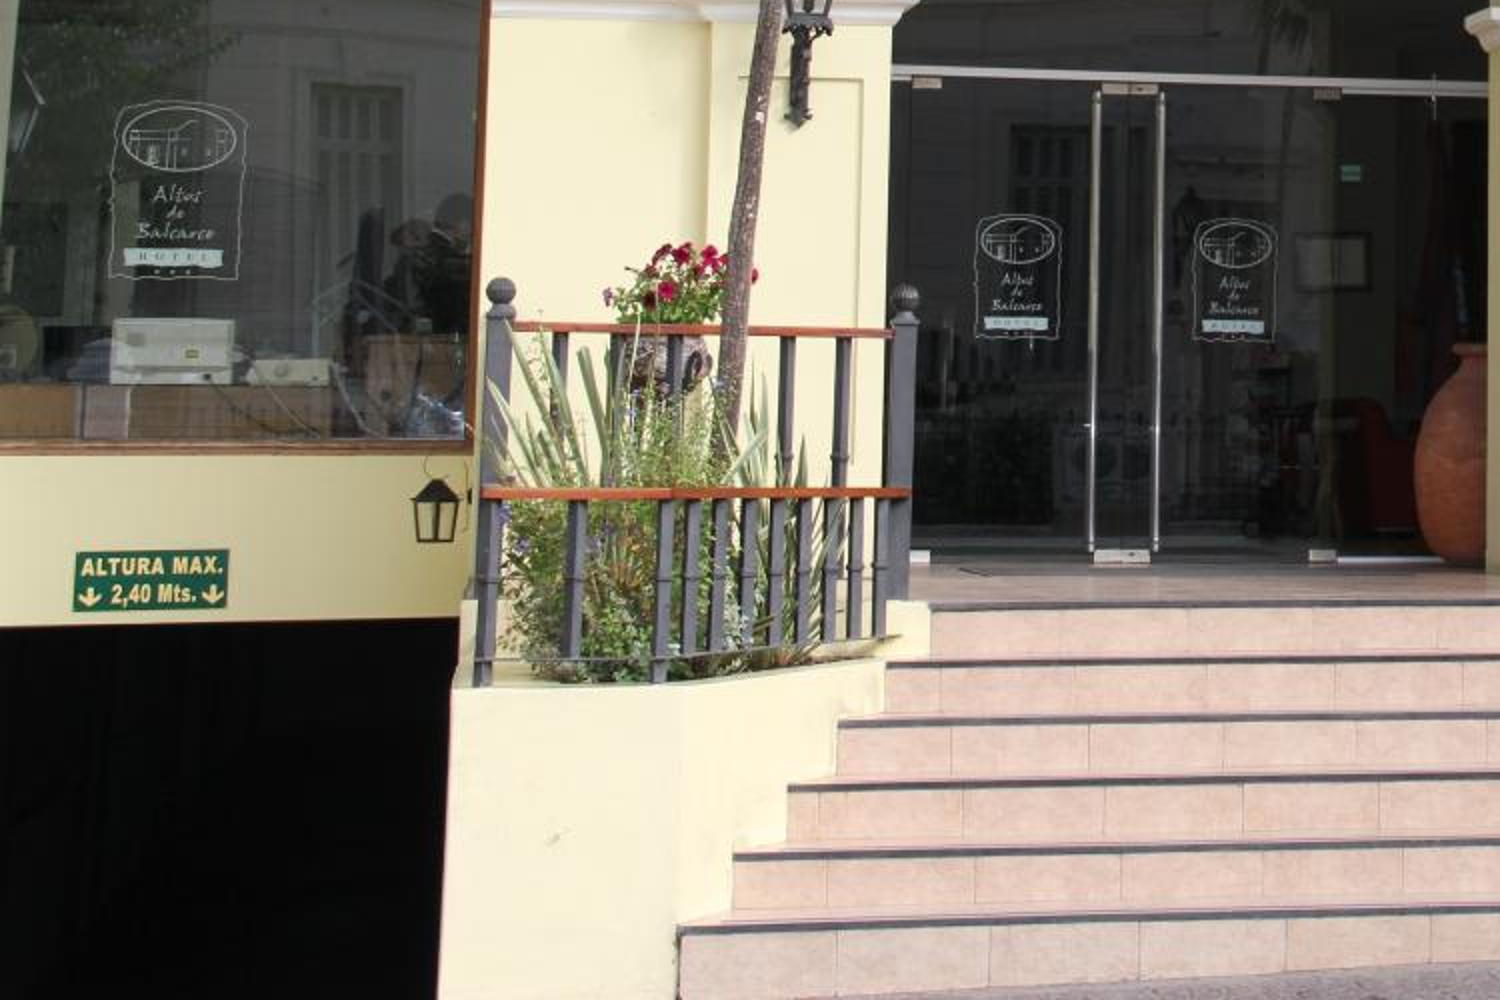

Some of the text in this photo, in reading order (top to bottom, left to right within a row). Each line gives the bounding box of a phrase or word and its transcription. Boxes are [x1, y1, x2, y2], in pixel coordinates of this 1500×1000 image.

[152, 183, 206, 204] Altos
[166, 204, 185, 219] de
[135, 221, 215, 240] Balcarce
[81, 556, 224, 577] ALTURA MAX.
[110, 584, 197, 608] 2,40 Mts.
